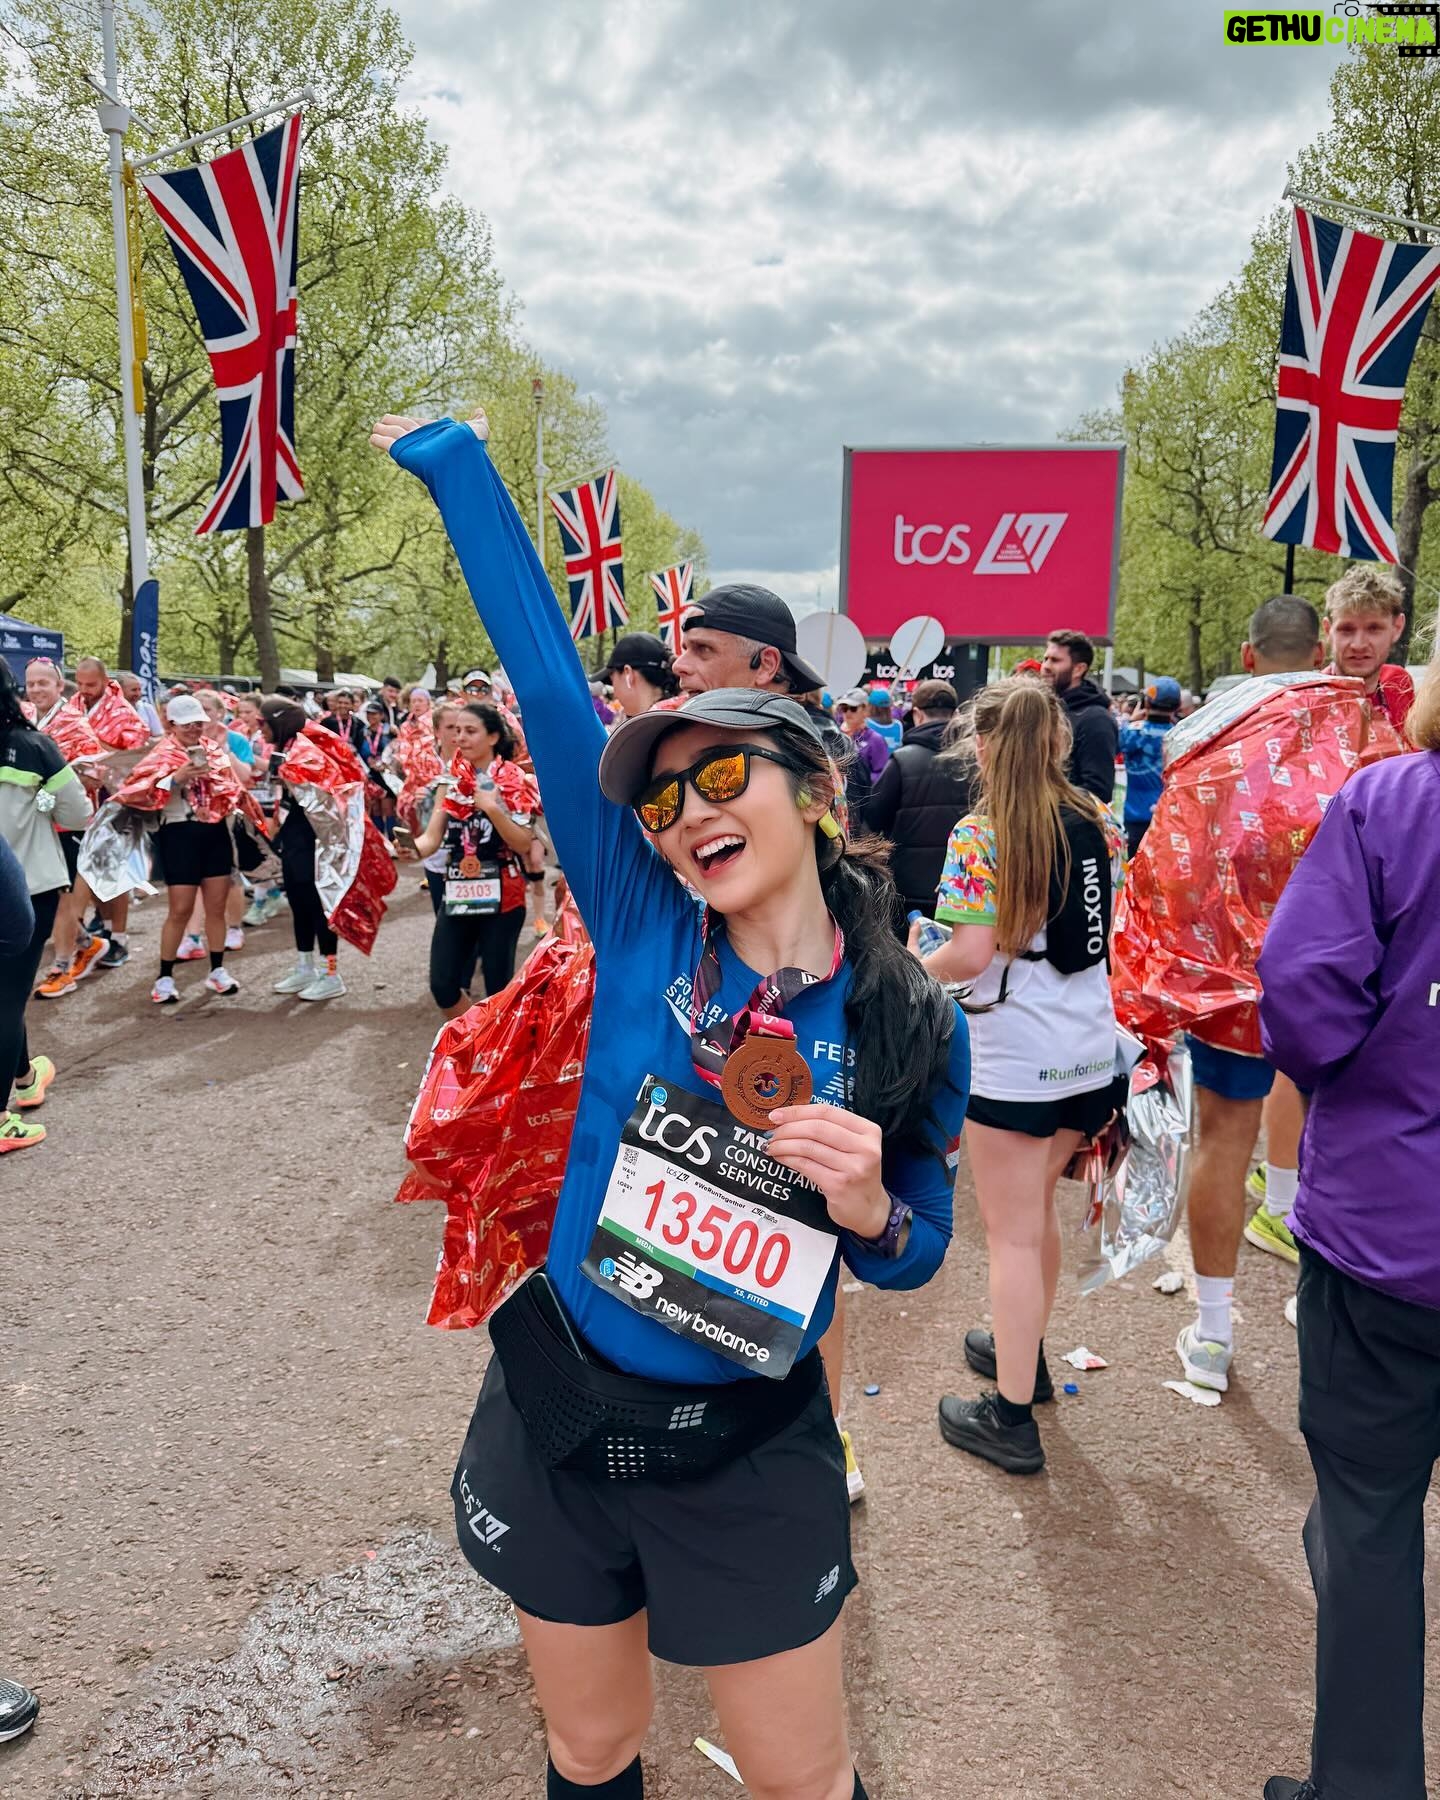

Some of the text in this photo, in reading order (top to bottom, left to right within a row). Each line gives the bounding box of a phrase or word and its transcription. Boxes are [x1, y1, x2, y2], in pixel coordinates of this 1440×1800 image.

[894, 514, 971, 565] tcs
[876, 663, 899, 679] tcs
[932, 663, 955, 679] tcs
[455, 884, 493, 898] 23103
[1082, 857, 1103, 955] INOXTO
[527, 1114, 551, 1127] tcs
[638, 1103, 719, 1166] tcs
[733, 1126, 768, 1152] TAT
[717, 1162, 791, 1201] SERVICES
[694, 1181, 746, 1209] #WeRunTogether
[635, 1237, 655, 1253] MEDAL
[645, 1179, 791, 1288] 13500
[733, 1287, 769, 1307] XS, FITTED
[492, 1544, 502, 1553] 24
